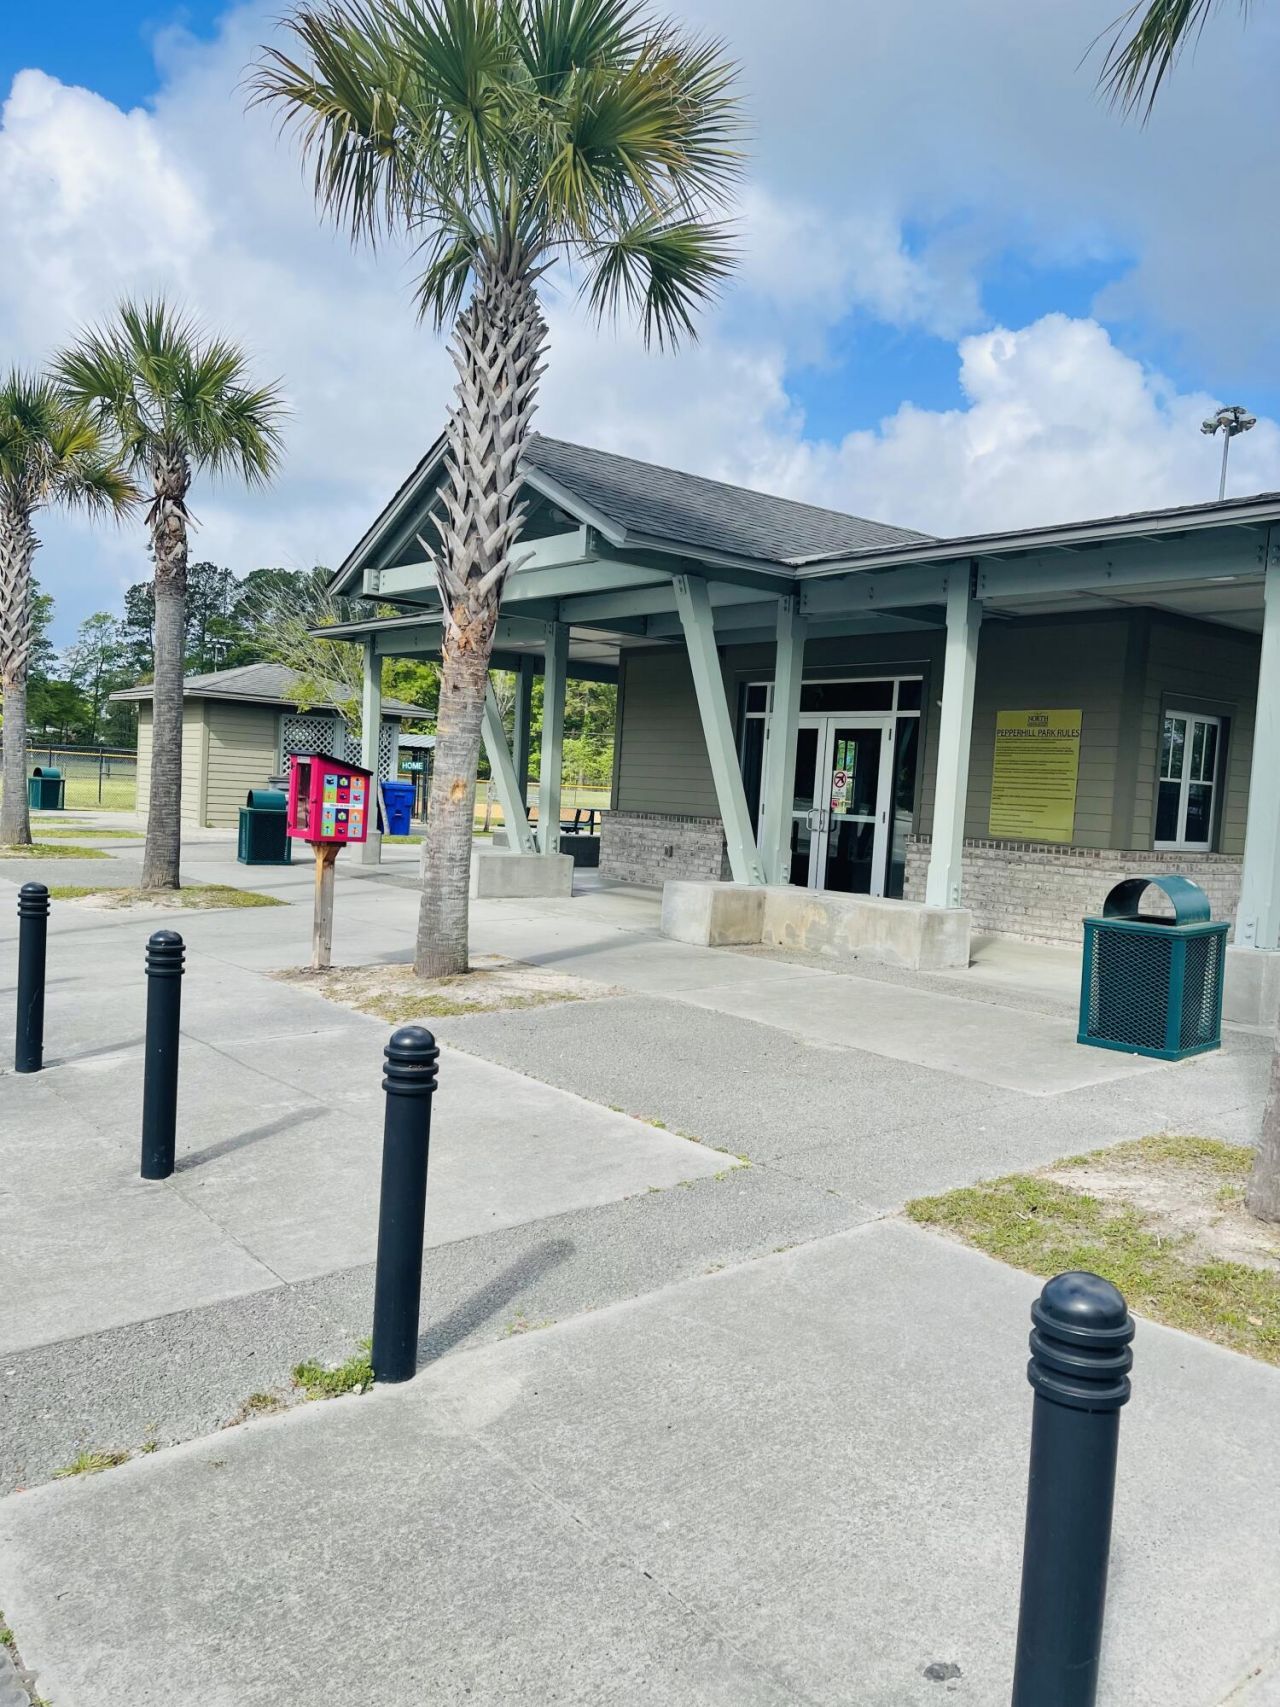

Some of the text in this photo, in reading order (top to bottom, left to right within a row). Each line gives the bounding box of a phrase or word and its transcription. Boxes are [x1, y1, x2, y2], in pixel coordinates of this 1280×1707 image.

[997, 728, 1080, 737] PEPPERHILL PARK RULES
[402, 762, 424, 770] HOME
